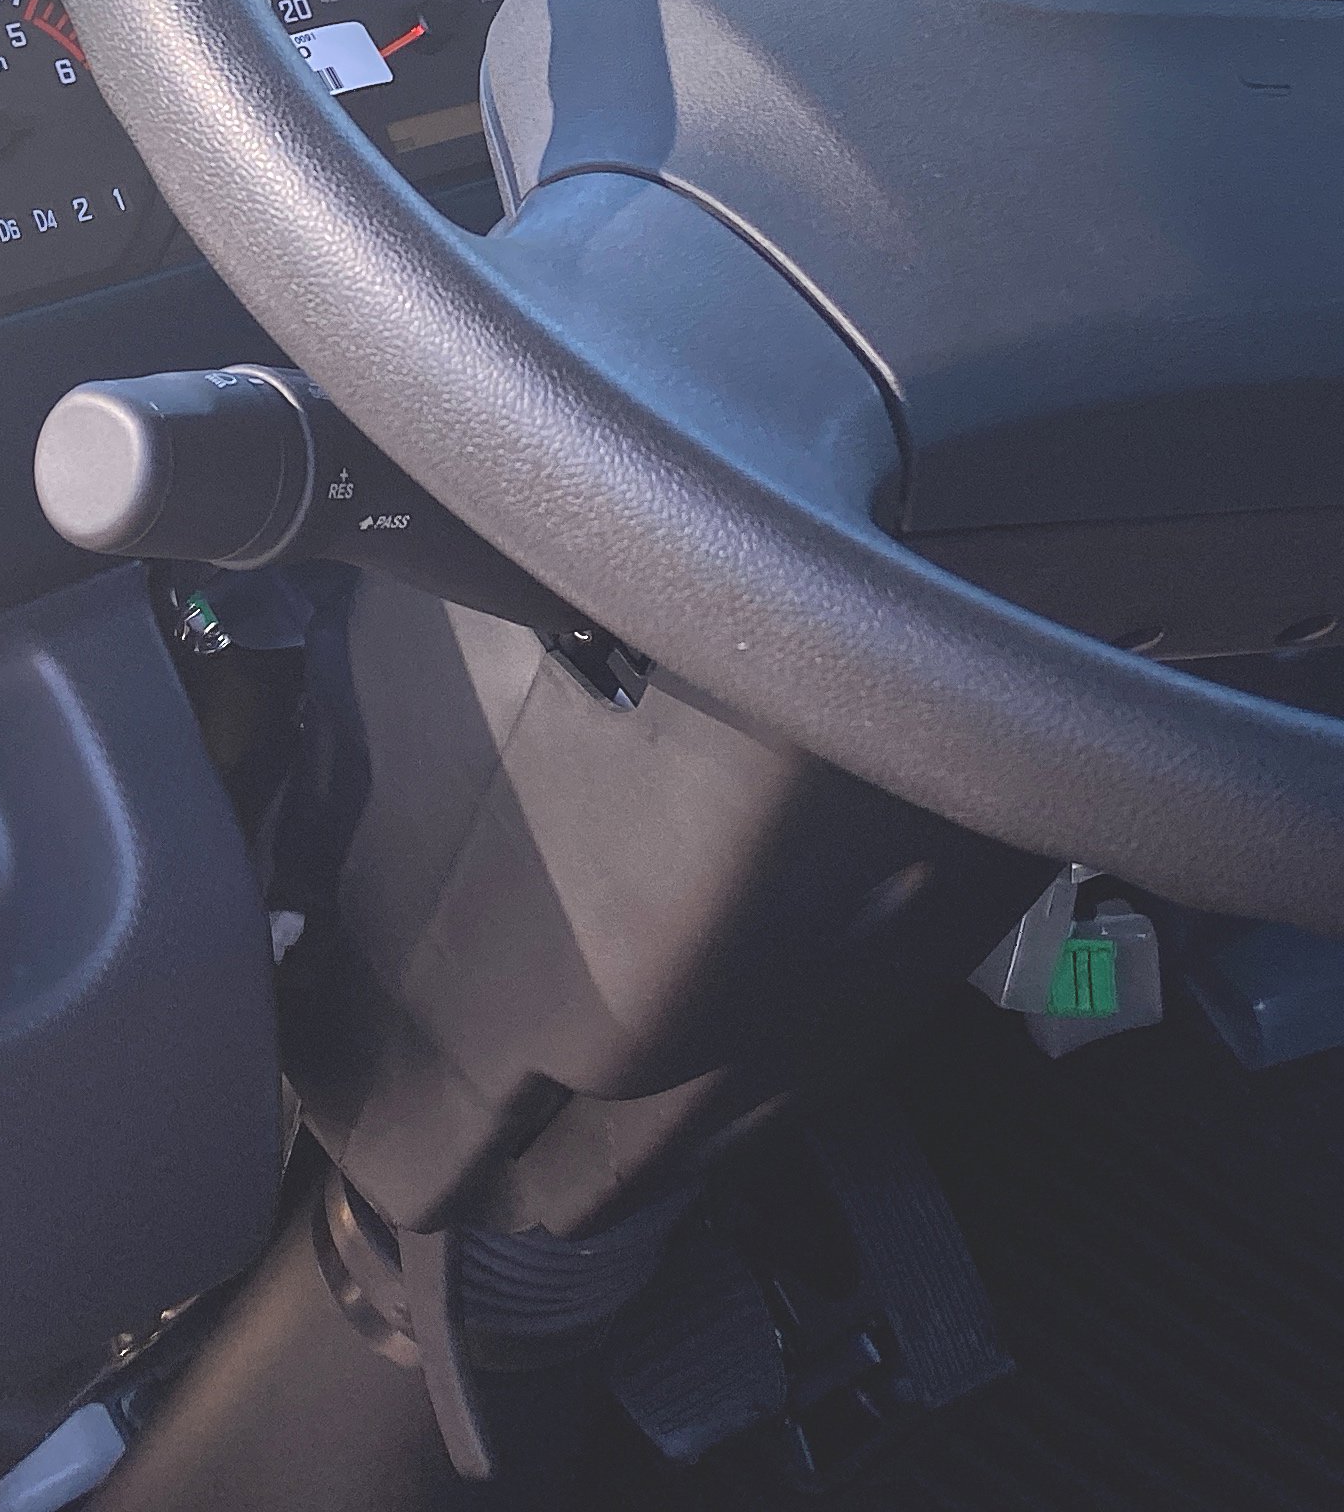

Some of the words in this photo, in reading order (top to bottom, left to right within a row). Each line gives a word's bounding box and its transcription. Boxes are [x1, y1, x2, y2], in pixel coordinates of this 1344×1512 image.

[6, 23, 27, 48] 5
[55, 59, 76, 85] 6
[33, 209, 58, 233] D4
[73, 197, 93, 222] 2
[112, 188, 127, 212] 1
[327, 483, 354, 500] RES
[373, 514, 411, 529] PASS
